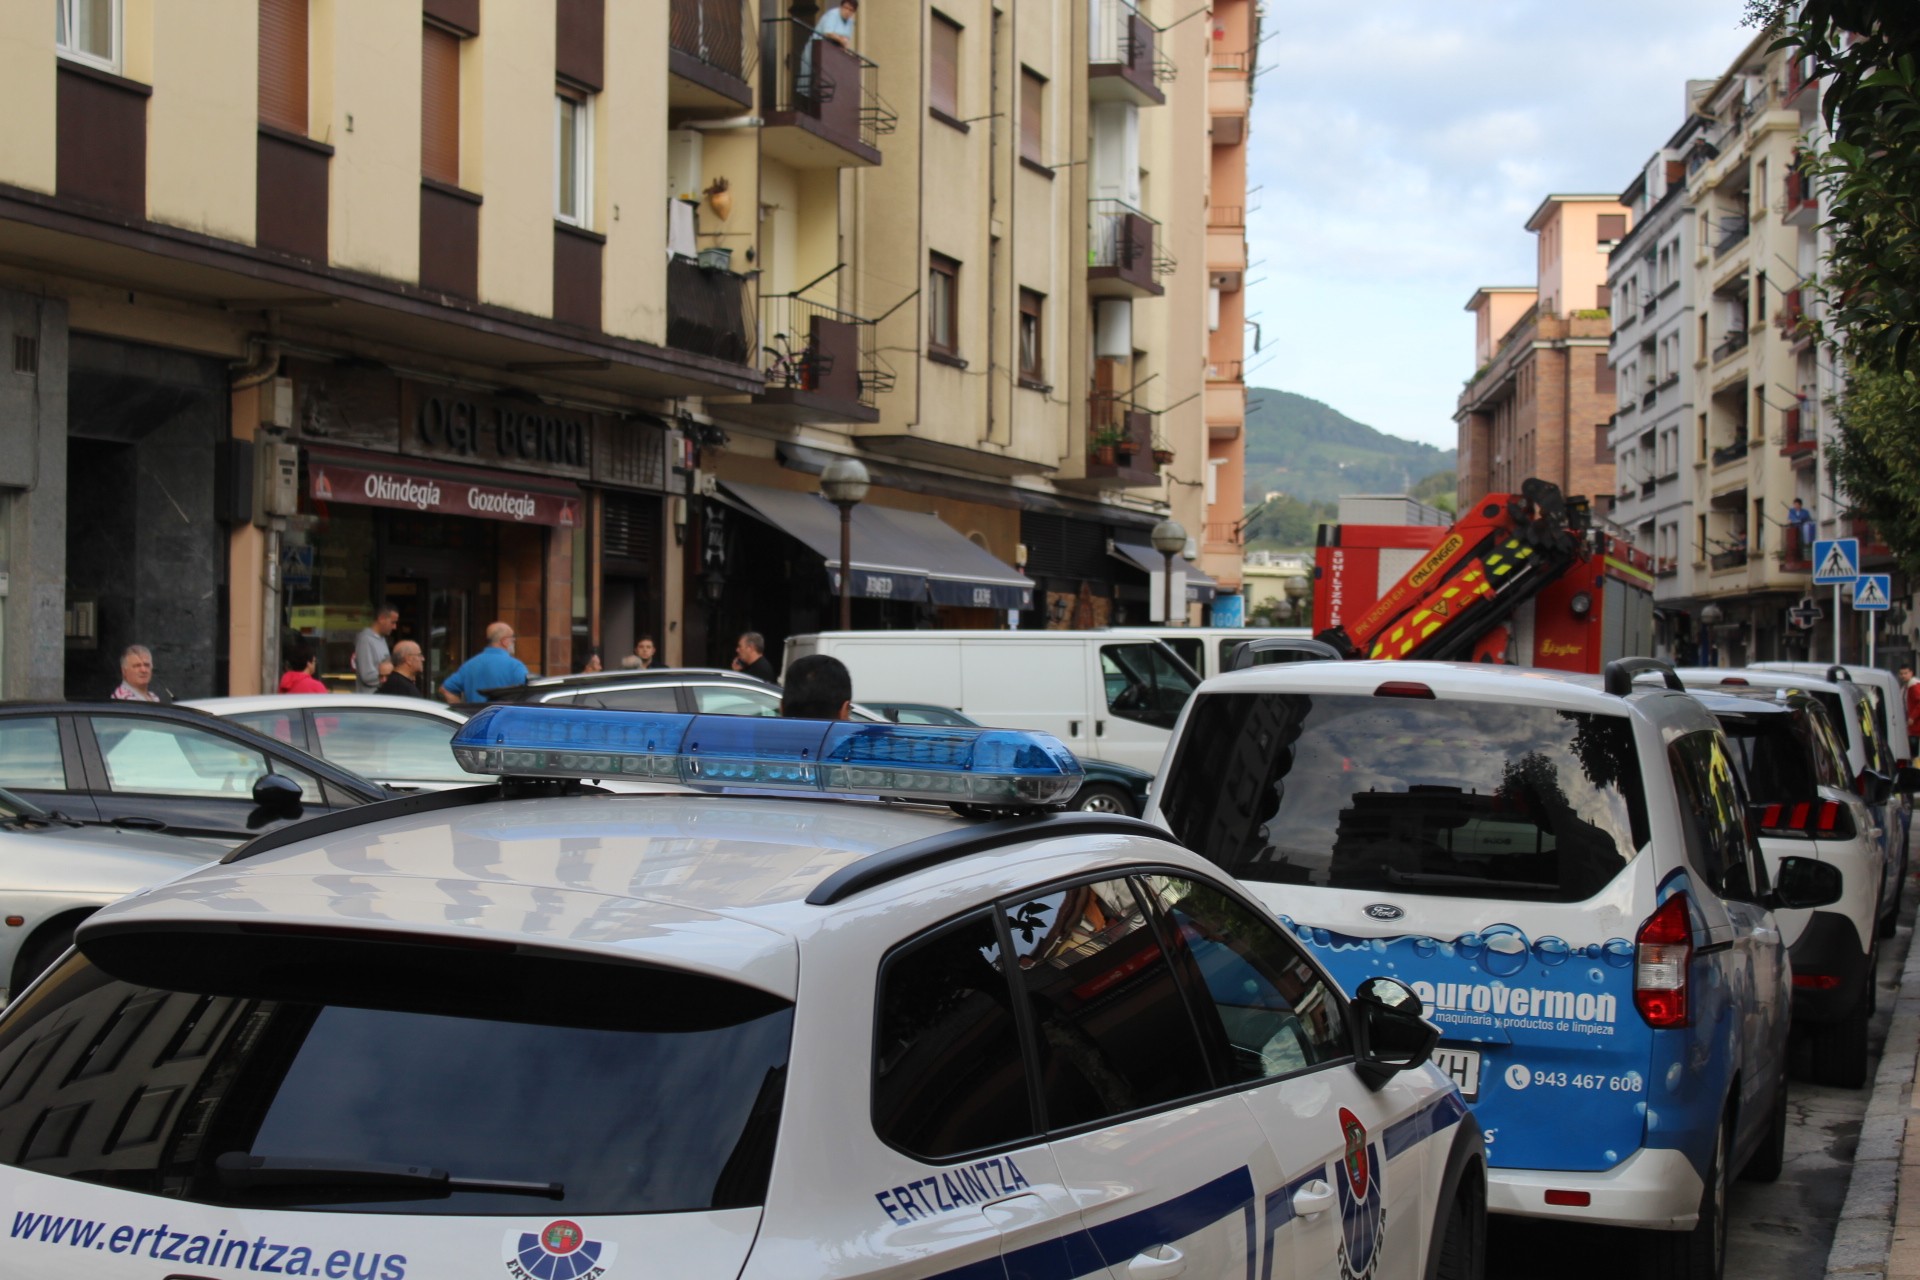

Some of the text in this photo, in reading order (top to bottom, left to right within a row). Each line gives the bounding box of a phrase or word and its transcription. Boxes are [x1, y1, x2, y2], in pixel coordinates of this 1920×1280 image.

[364, 474, 536, 521] Okindegia Gozotegia
[1411, 536, 1461, 587] PALFINGER
[1330, 550, 1344, 628] SUHILTZAILE
[1355, 621, 1370, 636] PK
[1410, 981, 1617, 1023] eurovermon
[1435, 1013, 1492, 1027] maquinaria
[1503, 1017, 1554, 1031] productos
[1556, 1020, 1569, 1032] de
[1572, 1022, 1614, 1036] limpieza
[1533, 1071, 1643, 1092] 943 467 608
[875, 1155, 1031, 1226] ERTZAINTZA
[10, 1210, 408, 1280] www.ertzaintza.eus
